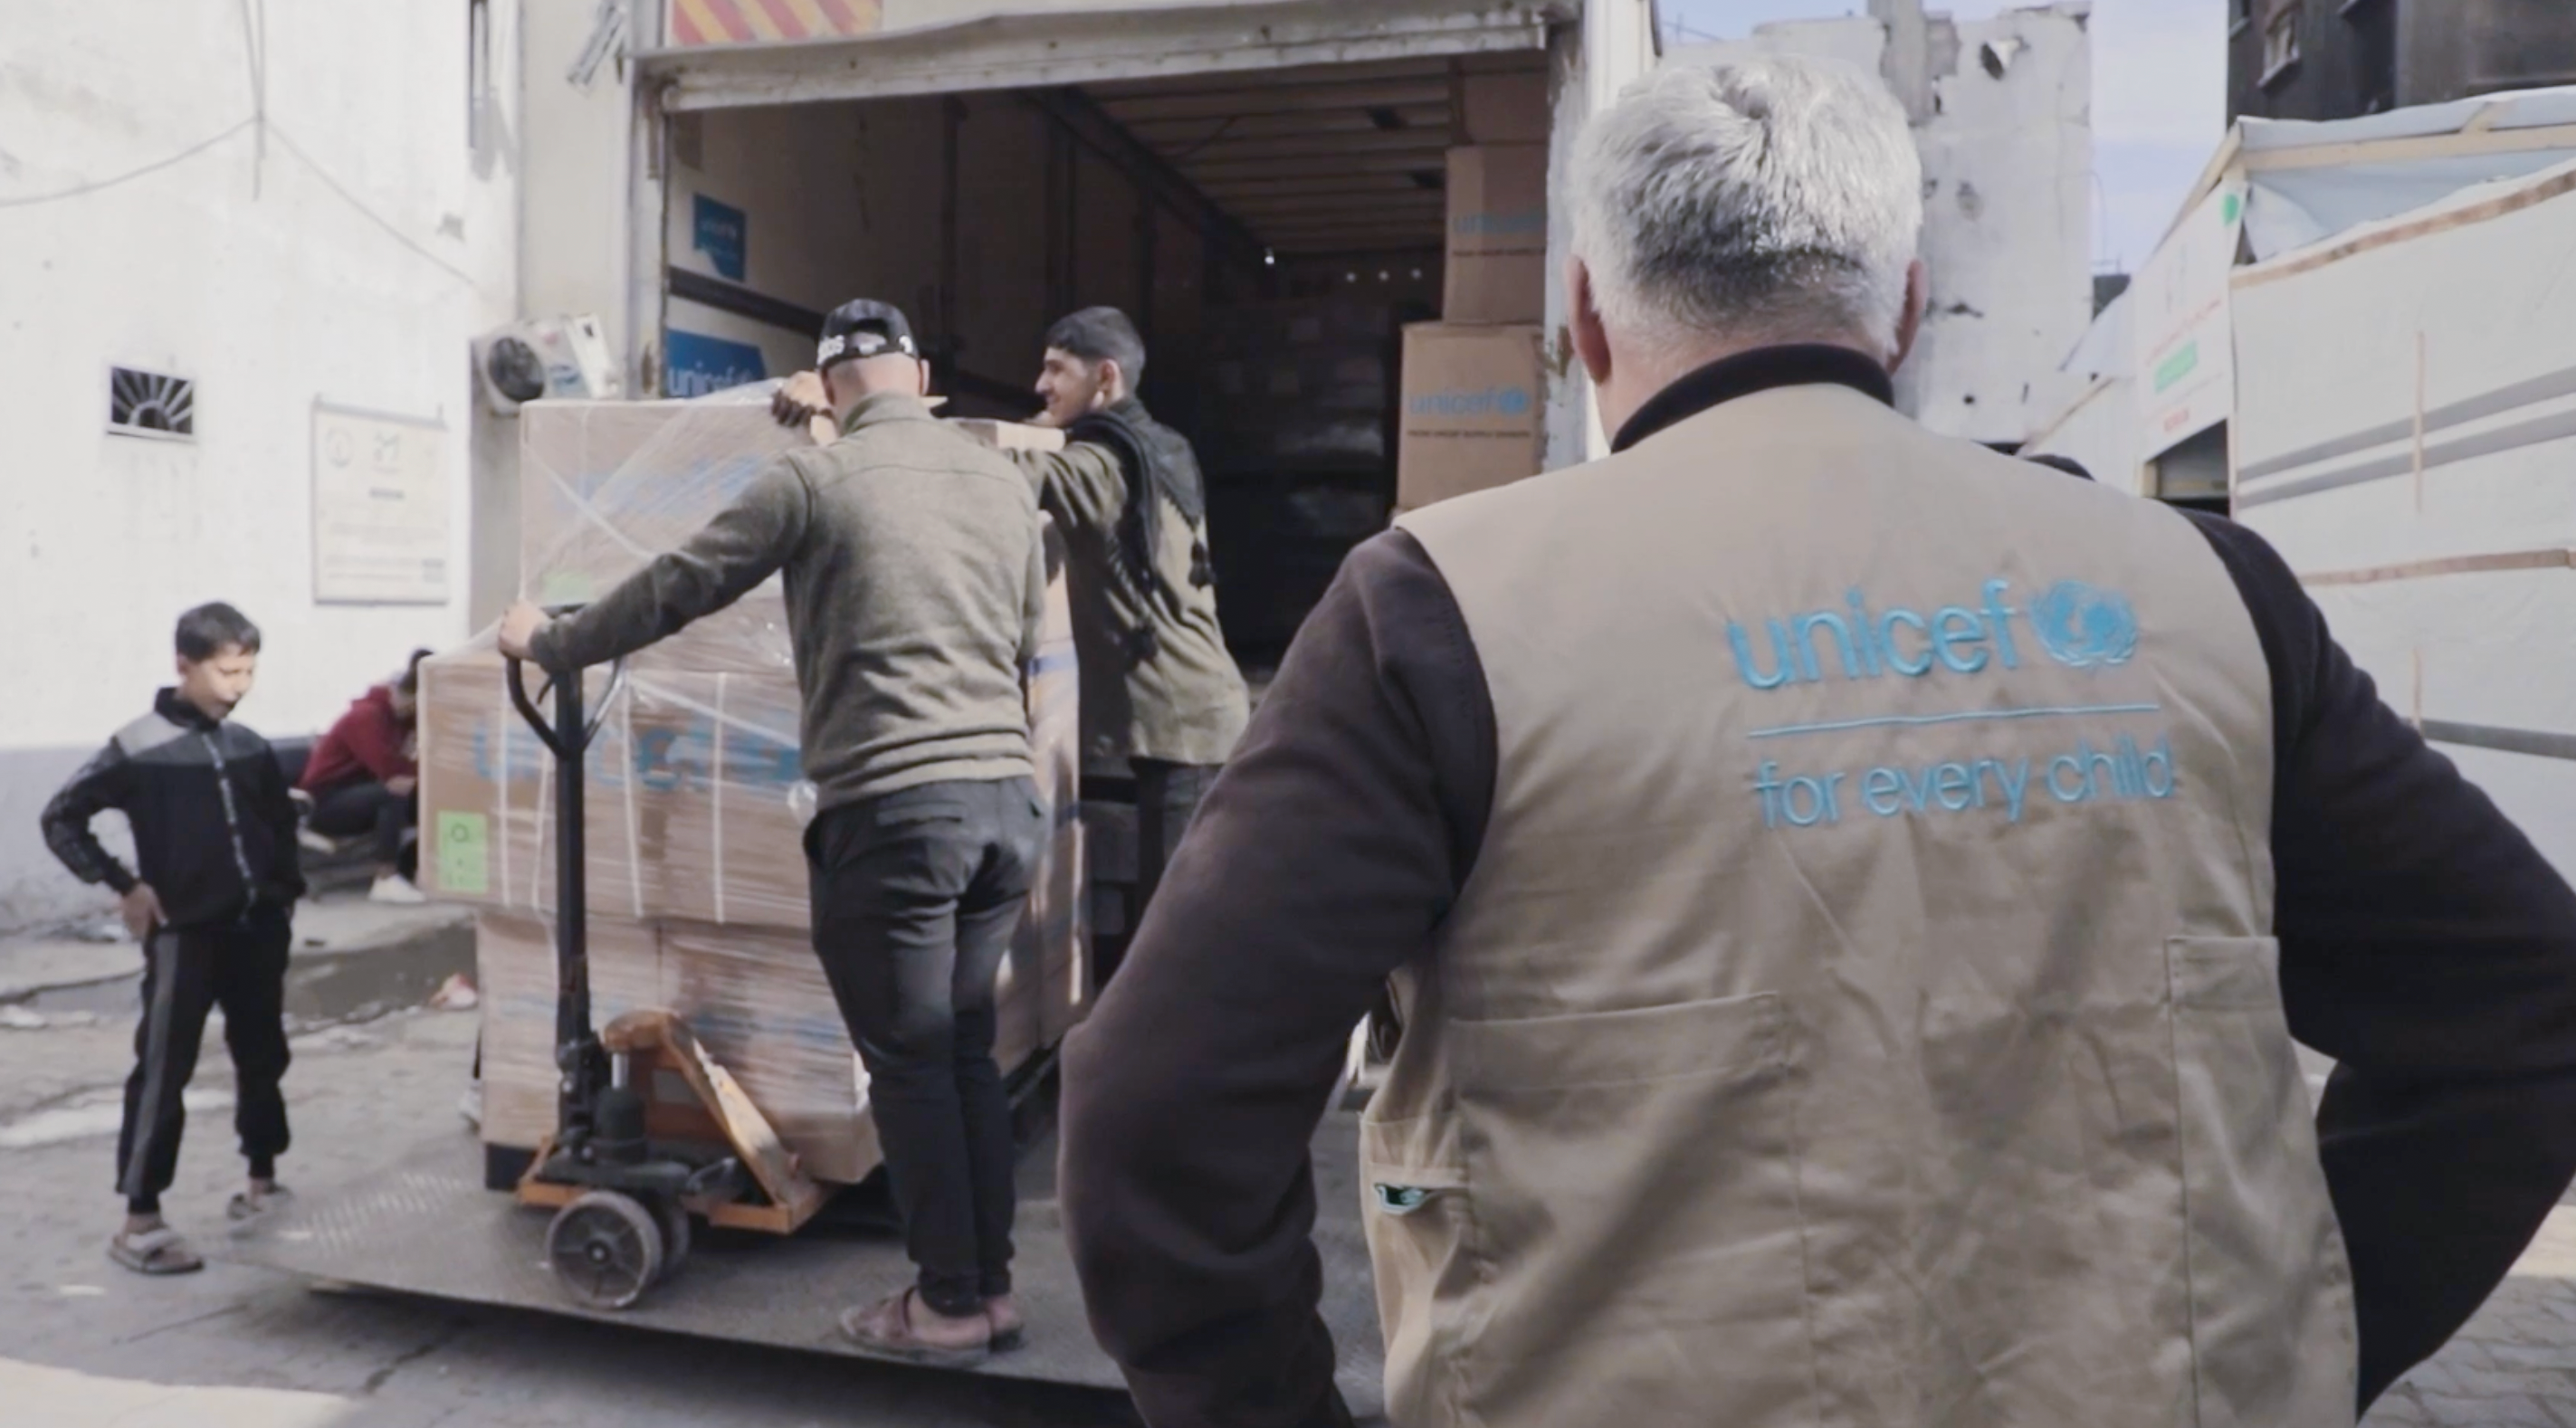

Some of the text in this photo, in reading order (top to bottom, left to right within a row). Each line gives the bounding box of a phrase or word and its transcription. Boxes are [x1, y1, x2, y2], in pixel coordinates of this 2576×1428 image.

[1726, 577, 2018, 690] unicef
[1753, 733, 2176, 828] for every child
